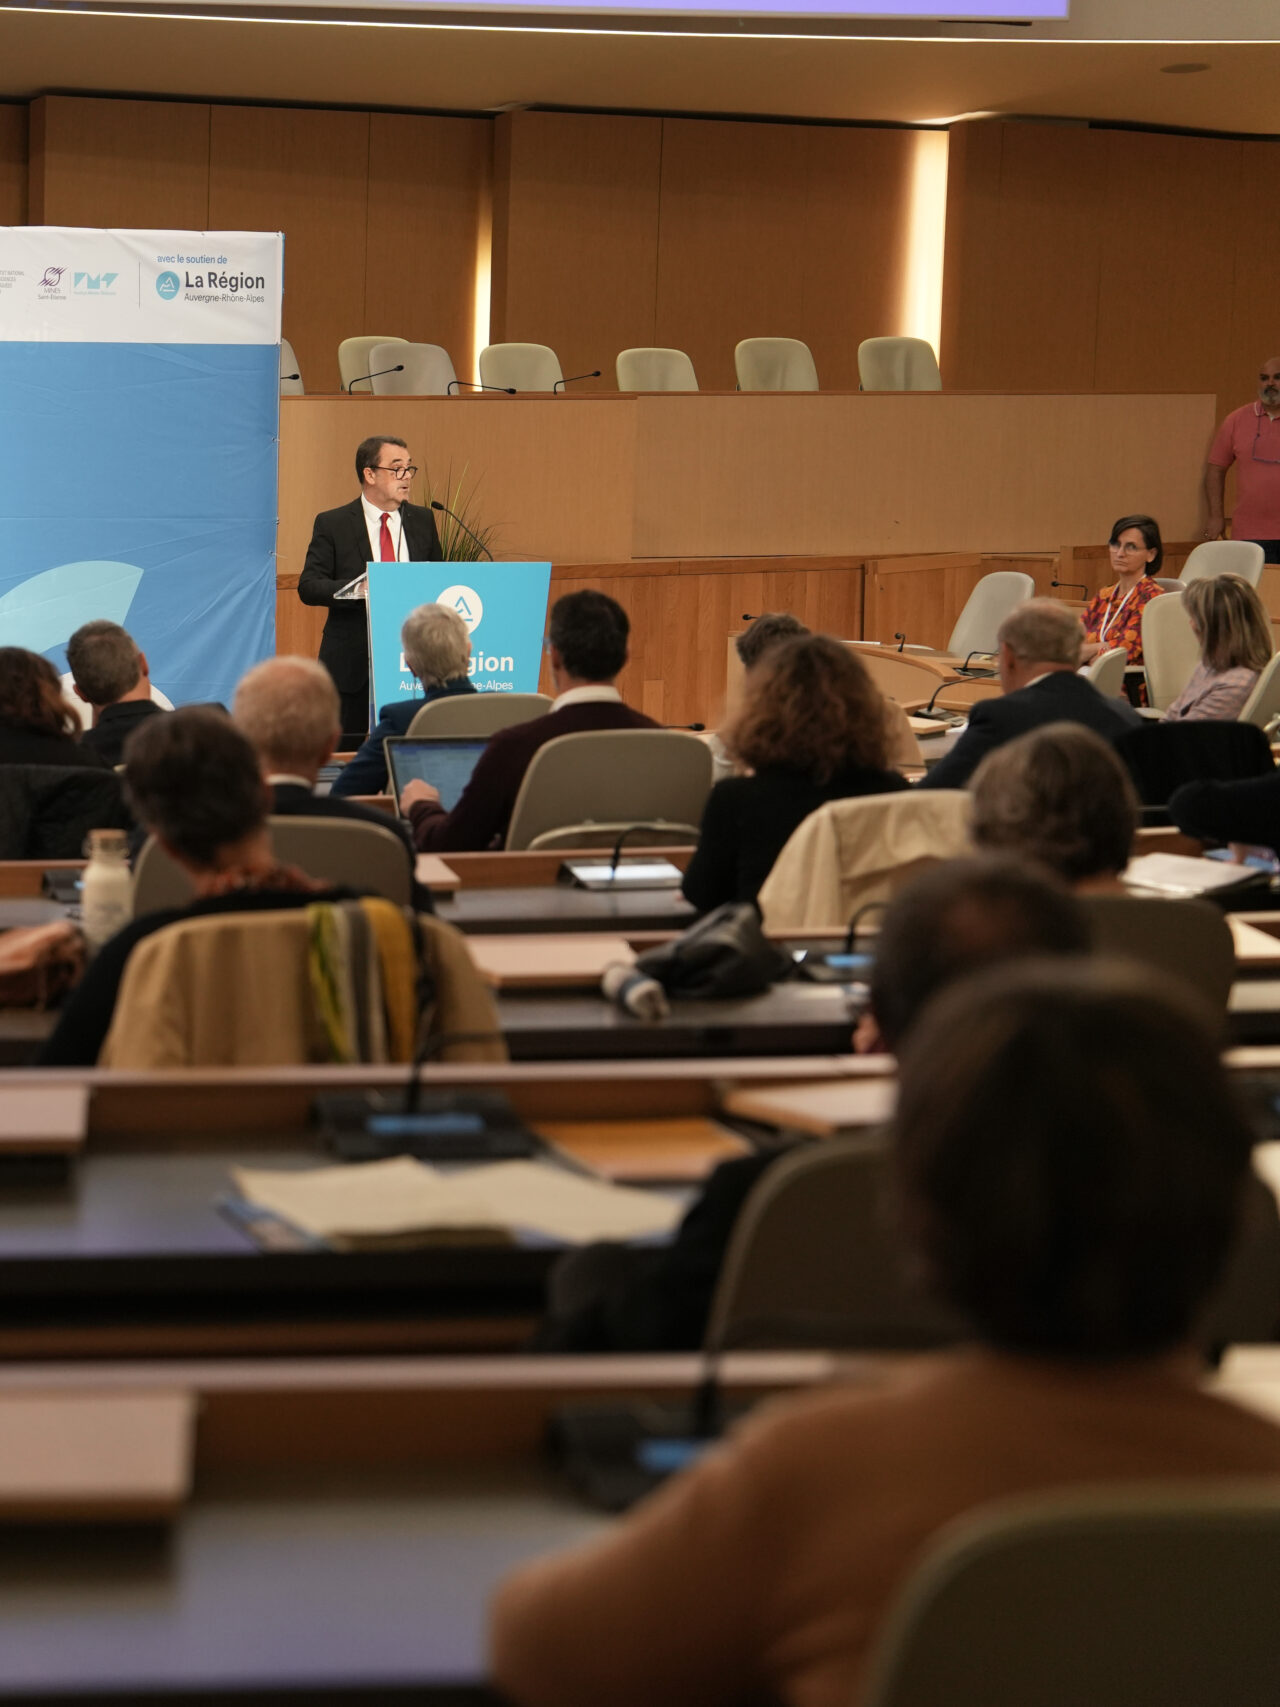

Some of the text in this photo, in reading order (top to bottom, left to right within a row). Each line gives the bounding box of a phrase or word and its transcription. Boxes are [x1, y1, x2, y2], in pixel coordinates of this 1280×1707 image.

[157, 254, 228, 264] avec le soutien de
[185, 271, 265, 293] La Région
